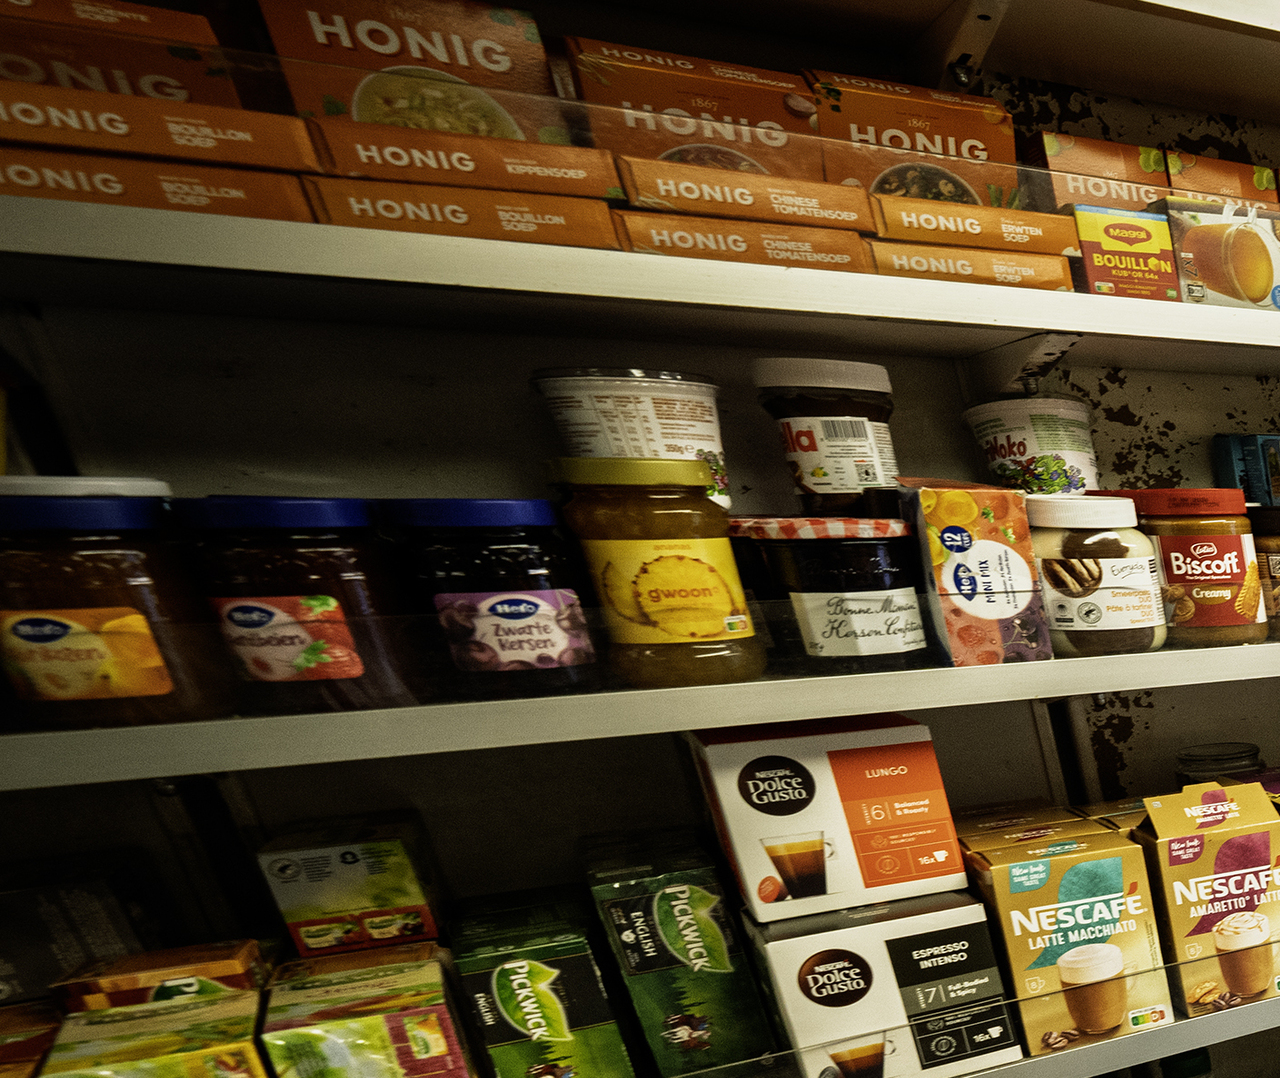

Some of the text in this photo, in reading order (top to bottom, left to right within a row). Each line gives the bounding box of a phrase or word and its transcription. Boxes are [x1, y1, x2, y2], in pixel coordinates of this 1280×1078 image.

[308, 9, 513, 74] HONIG
[601, 47, 695, 70] HONIG
[621, 100, 790, 148] HONIG
[850, 122, 989, 164] HONIG
[355, 143, 477, 173] HONIG
[656, 178, 755, 206] HONIG
[1067, 175, 1159, 203] HONIG
[770, 192, 820, 209] CHINESE
[349, 197, 470, 226] HONIG
[499, 210, 566, 226] BOUILLON
[772, 201, 859, 223] TOMATENSOEP
[901, 210, 982, 236] HONIG
[1001, 222, 1043, 238] ERWTEN
[1108, 225, 1148, 240] Maggi
[651, 229, 748, 253] HONIG
[763, 238, 813, 252] CHINESE
[765, 247, 852, 266] TOMATENSOEP
[892, 252, 973, 276] HONIG
[1171, 550, 1240, 576] Biscoff
[1192, 588, 1231, 599] Creamy
[827, 596, 874, 616] Bonne
[865, 766, 908, 778] LUNGO
[747, 777, 803, 793] Dolce
[751, 789, 808, 804] Gusto
[894, 799, 929, 809] Balanced
[1185, 800, 1240, 818] NESCAFÉ
[1010, 881, 1147, 936] NESCAFÉ
[665, 885, 710, 972] PICKWICK
[1028, 920, 1138, 950] LATTE MACCHIATO
[912, 941, 969, 960] ESPRESSO
[920, 953, 968, 969] INTENSO
[806, 967, 861, 986] Dolce
[810, 982, 867, 998] Gusto
[503, 961, 550, 1041] PICKWICK
